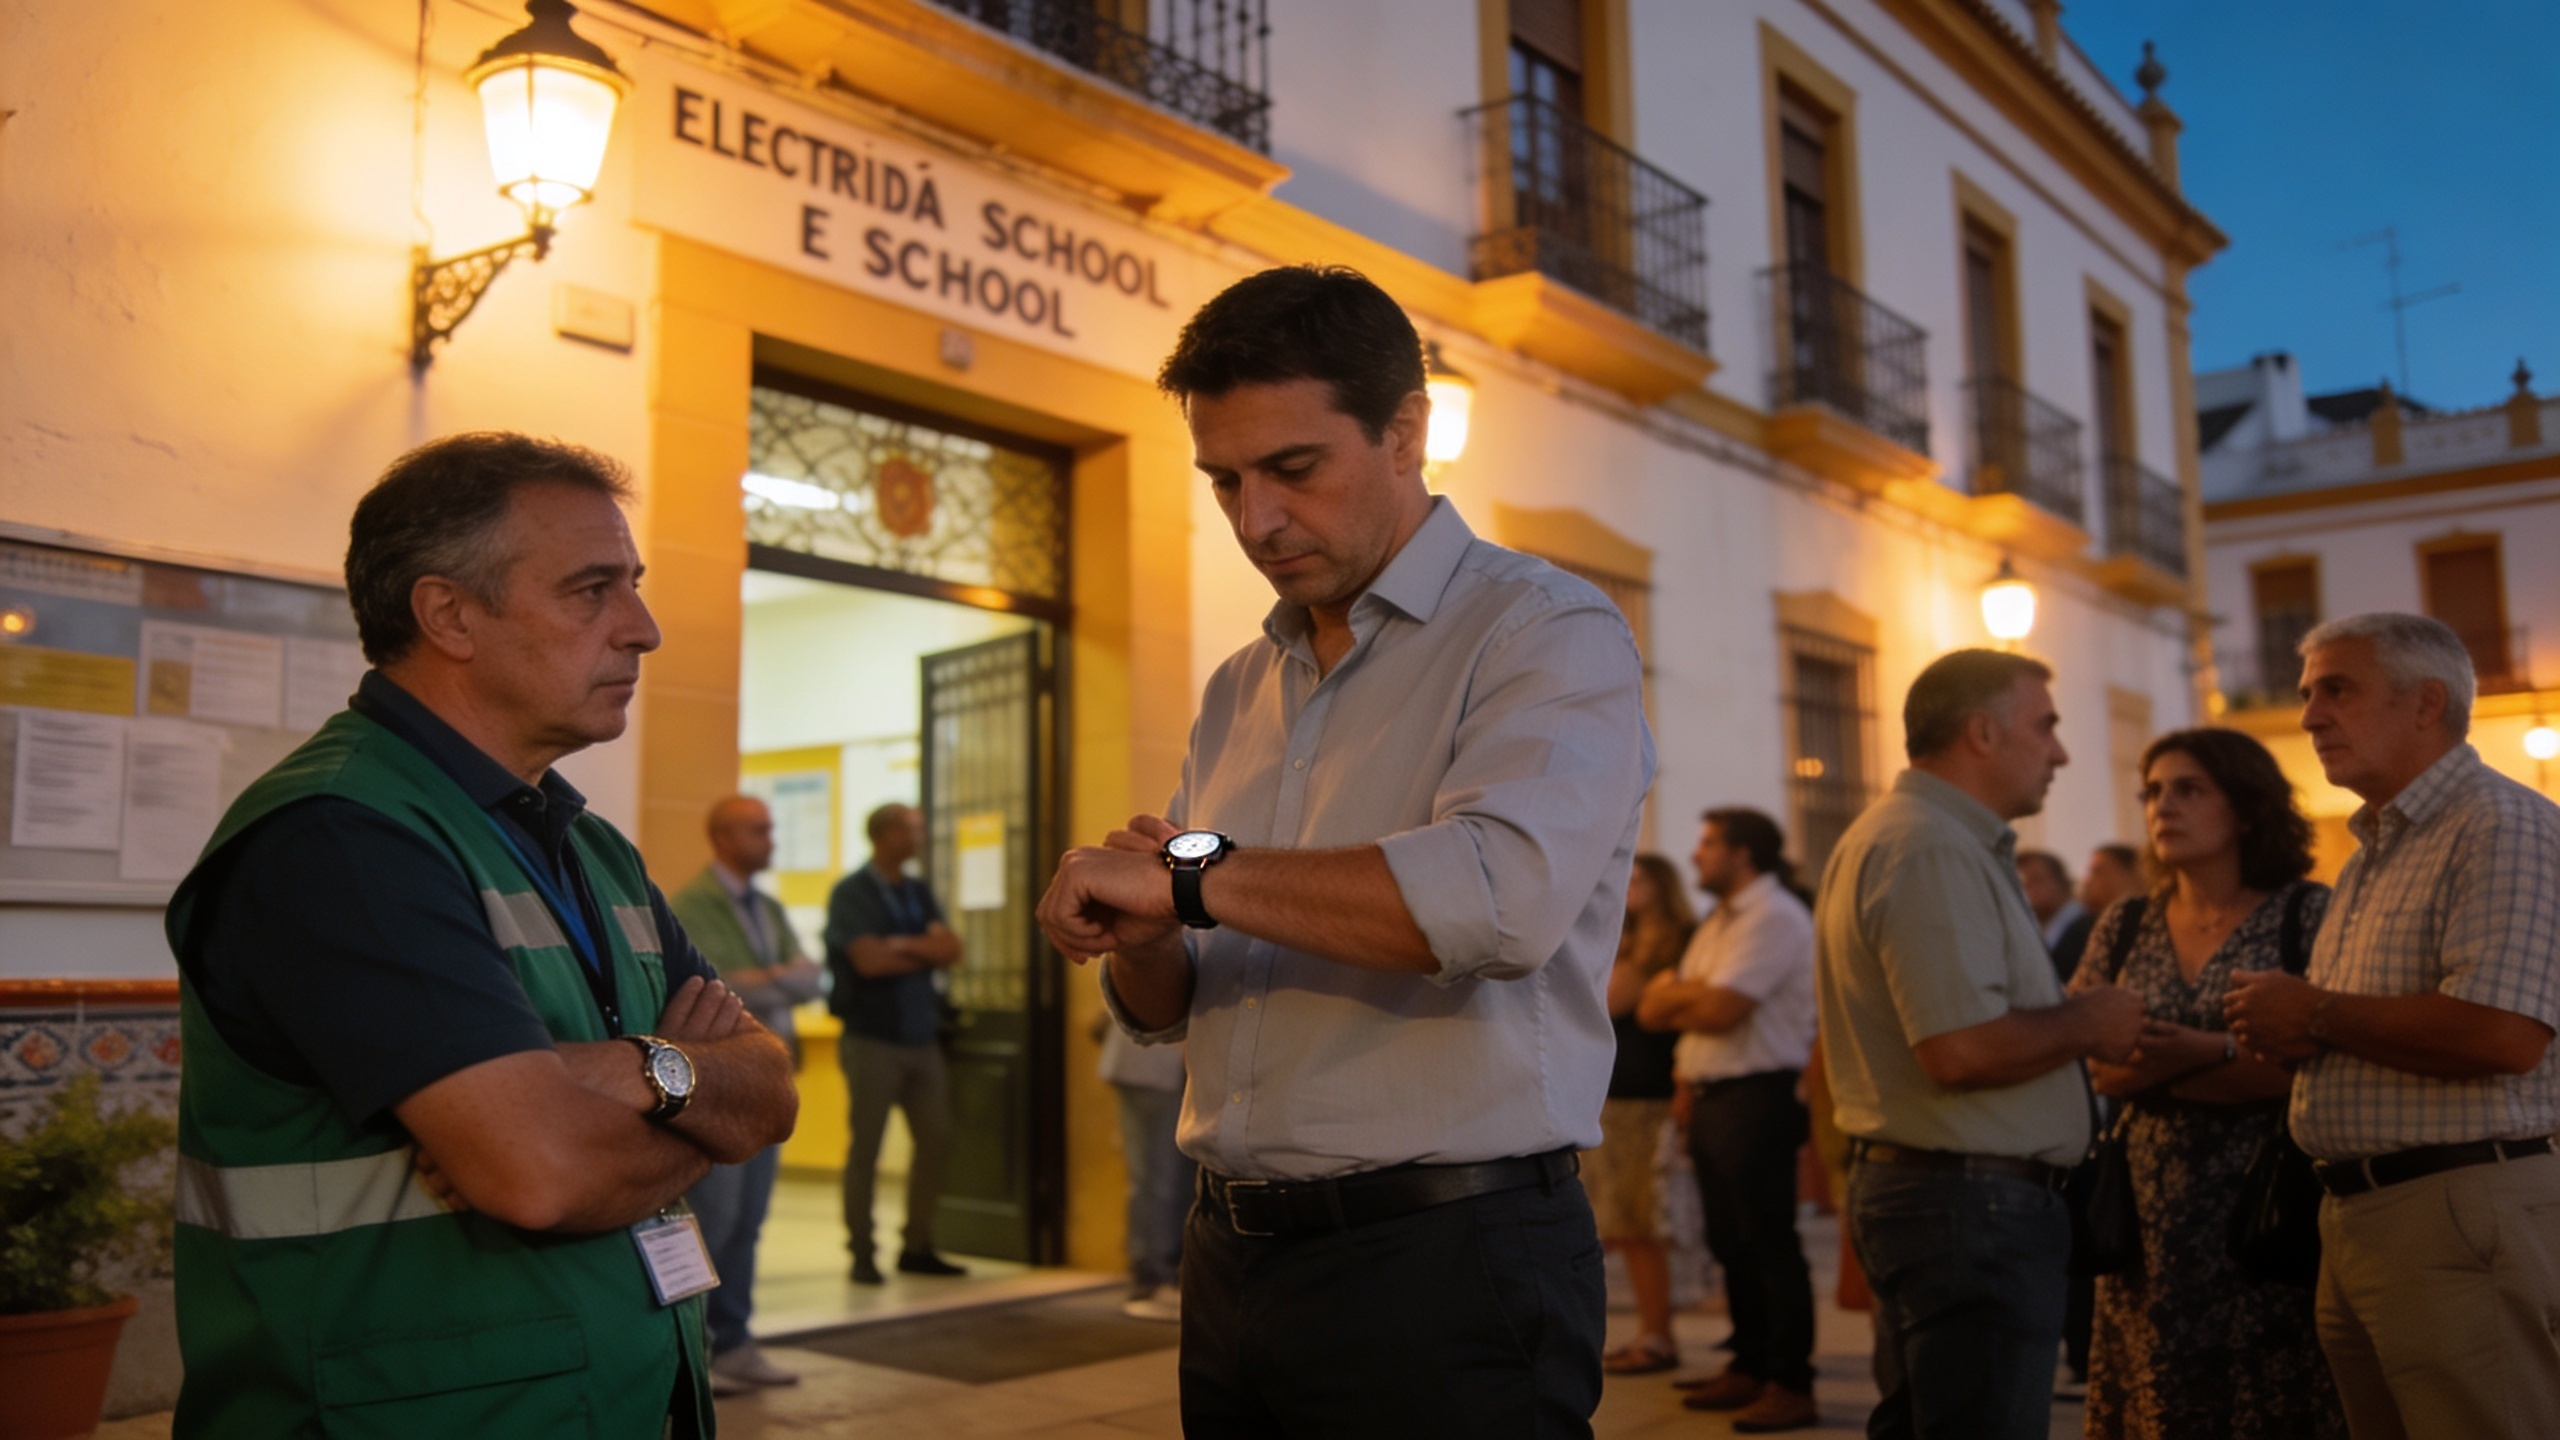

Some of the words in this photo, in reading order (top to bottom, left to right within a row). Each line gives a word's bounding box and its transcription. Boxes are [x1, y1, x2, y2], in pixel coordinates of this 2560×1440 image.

[802, 206, 831, 260] E
[865, 229, 1076, 338] SCHOOL
[982, 202, 1170, 309] SCHOOL
